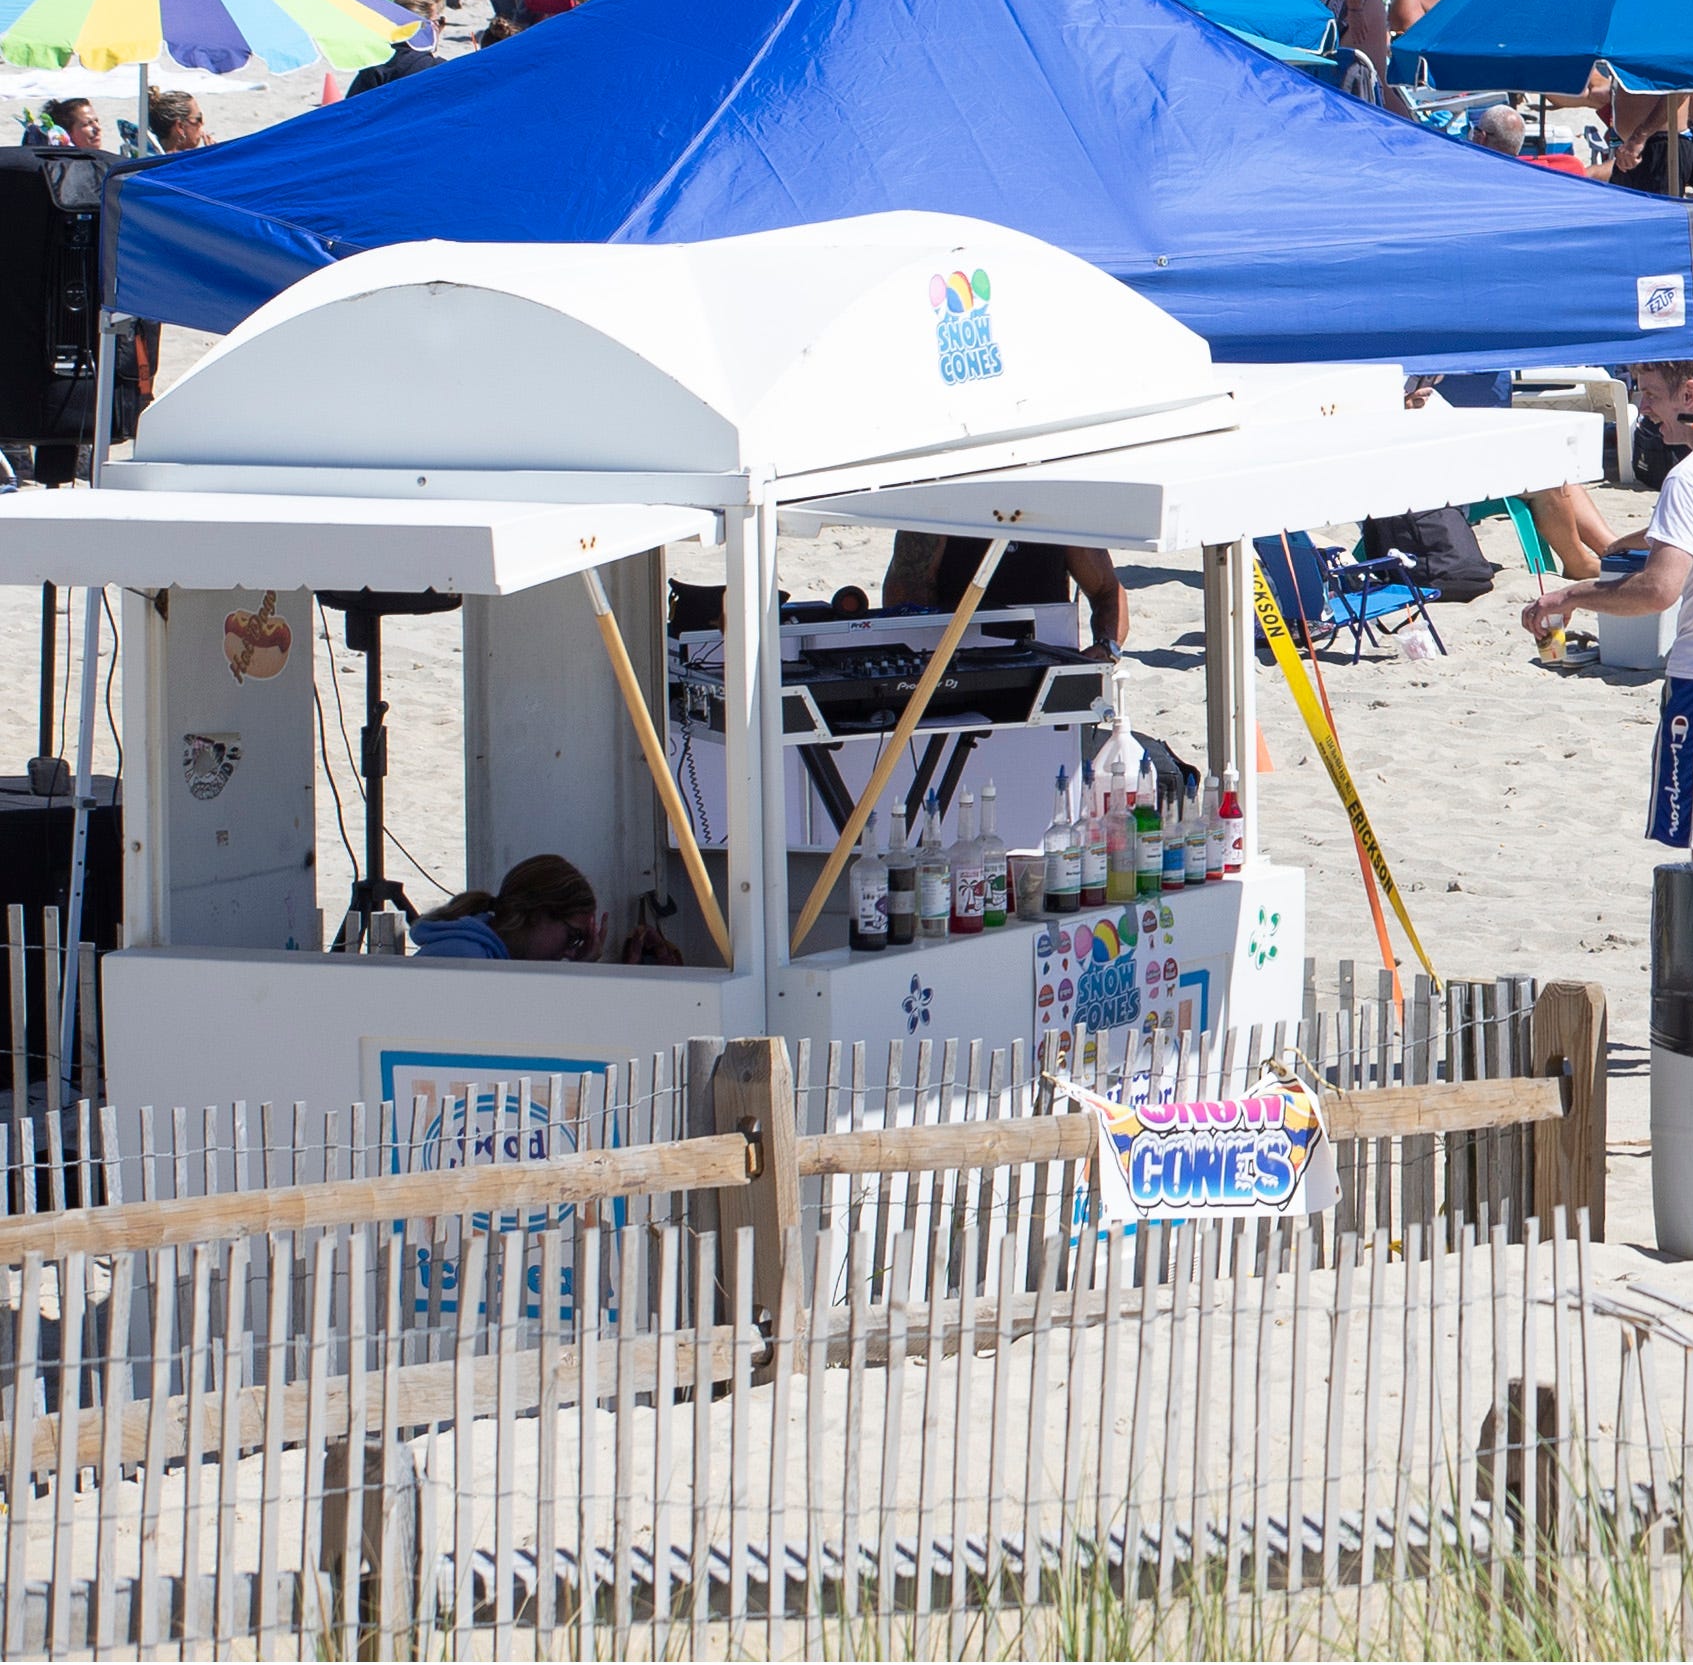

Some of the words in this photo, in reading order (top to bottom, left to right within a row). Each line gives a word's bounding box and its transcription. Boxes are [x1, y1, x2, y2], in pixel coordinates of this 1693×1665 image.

[937, 317, 990, 352] SNOW
[940, 345, 1002, 383] CONES
[1663, 715, 1690, 838] Champion
[1347, 800, 1395, 895] ERICKSON
[1077, 959, 1137, 1007] SNOW
[1072, 987, 1141, 1034] CONES
[1132, 1135, 1291, 1202] CONES
